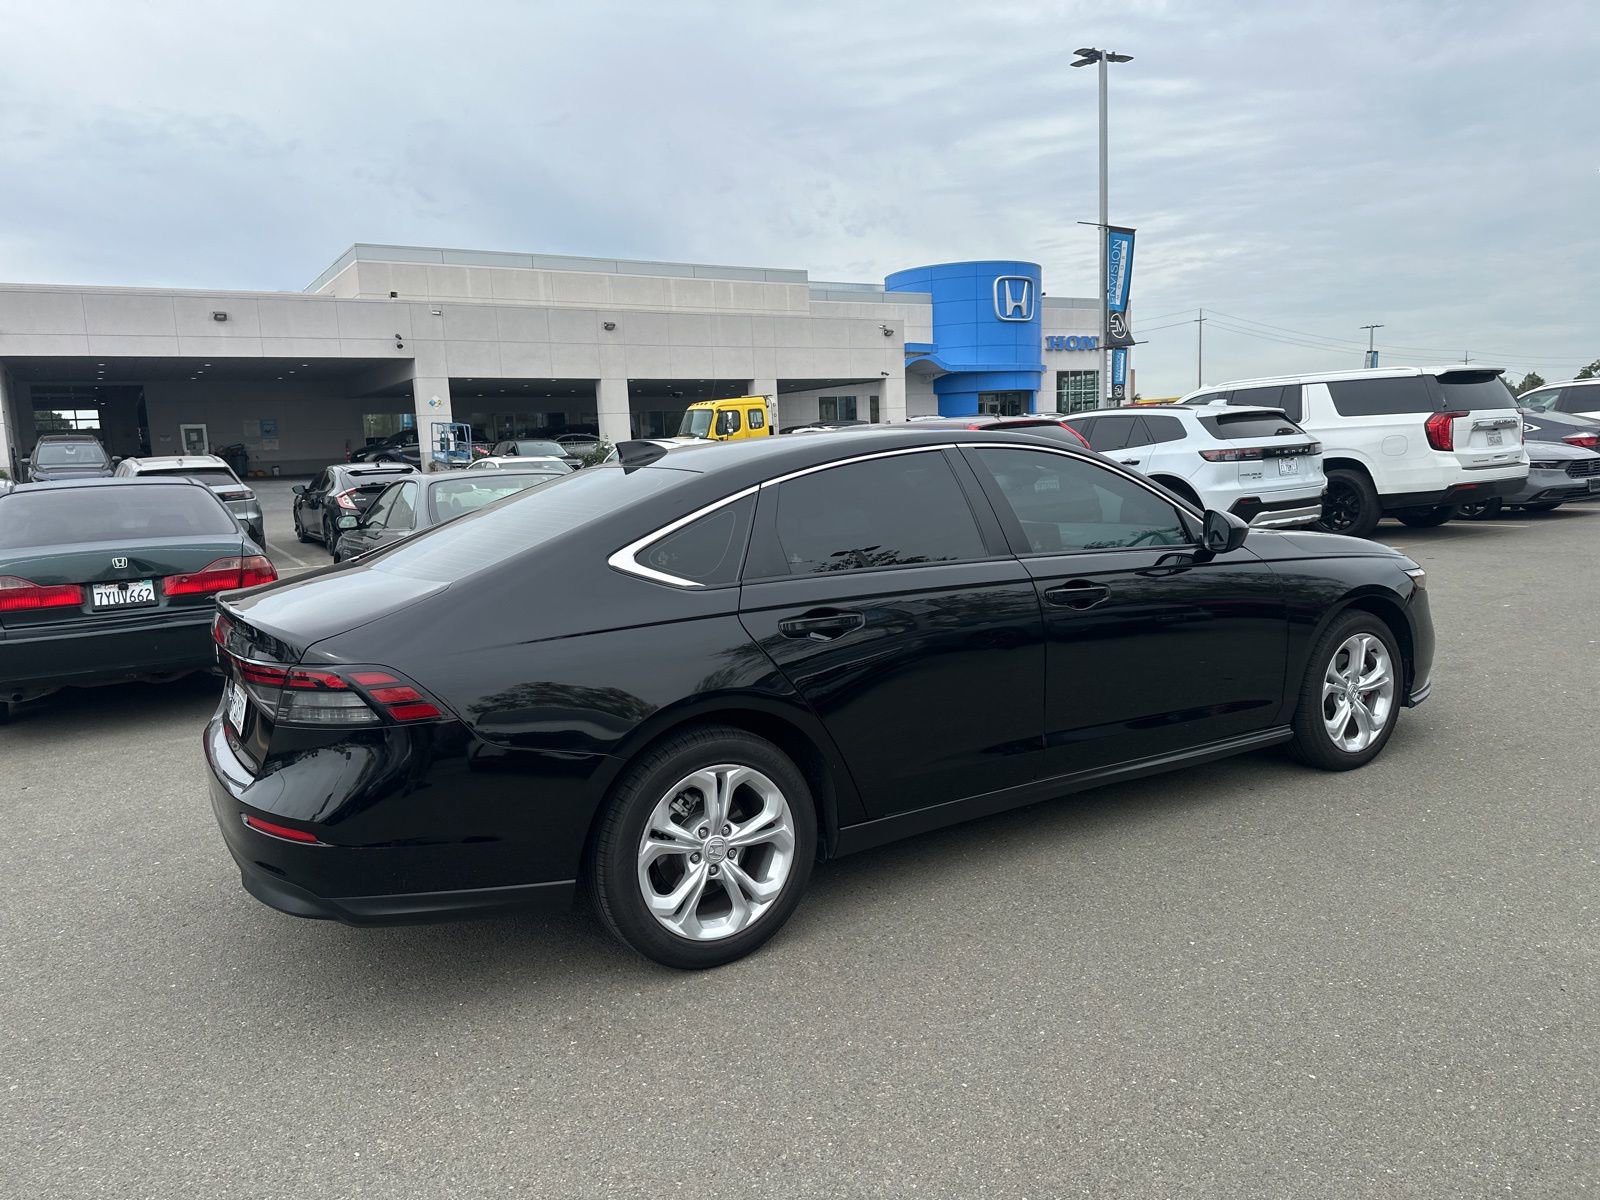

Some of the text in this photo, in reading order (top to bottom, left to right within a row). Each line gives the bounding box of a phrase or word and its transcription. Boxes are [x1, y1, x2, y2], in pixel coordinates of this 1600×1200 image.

[1110, 239, 1122, 305] ENVISION
[1045, 335, 1099, 352] HON
[96, 588, 153, 606] 7YUV662
